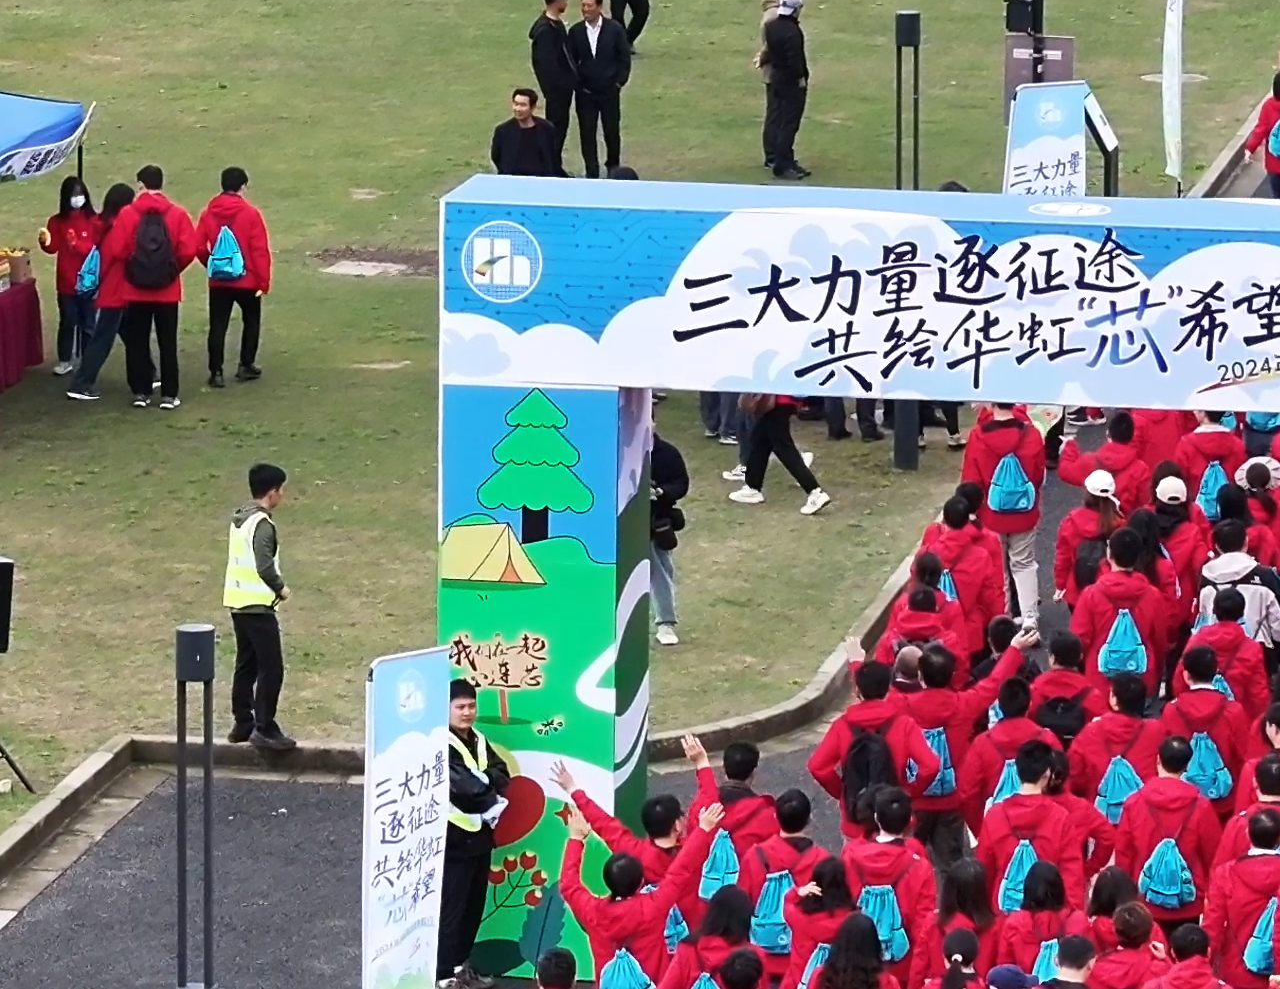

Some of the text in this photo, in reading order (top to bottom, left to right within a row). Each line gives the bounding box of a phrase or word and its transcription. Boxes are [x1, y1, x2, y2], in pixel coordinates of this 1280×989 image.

[1009, 150, 1083, 188] 三大力量
[672, 228, 1144, 344] 三大力量逐征途
[449, 633, 547, 672] 我们在一起
[373, 750, 446, 815] 三大力量
[380, 794, 441, 844] 逐征途
[371, 835, 443, 889] 共绘华虹
